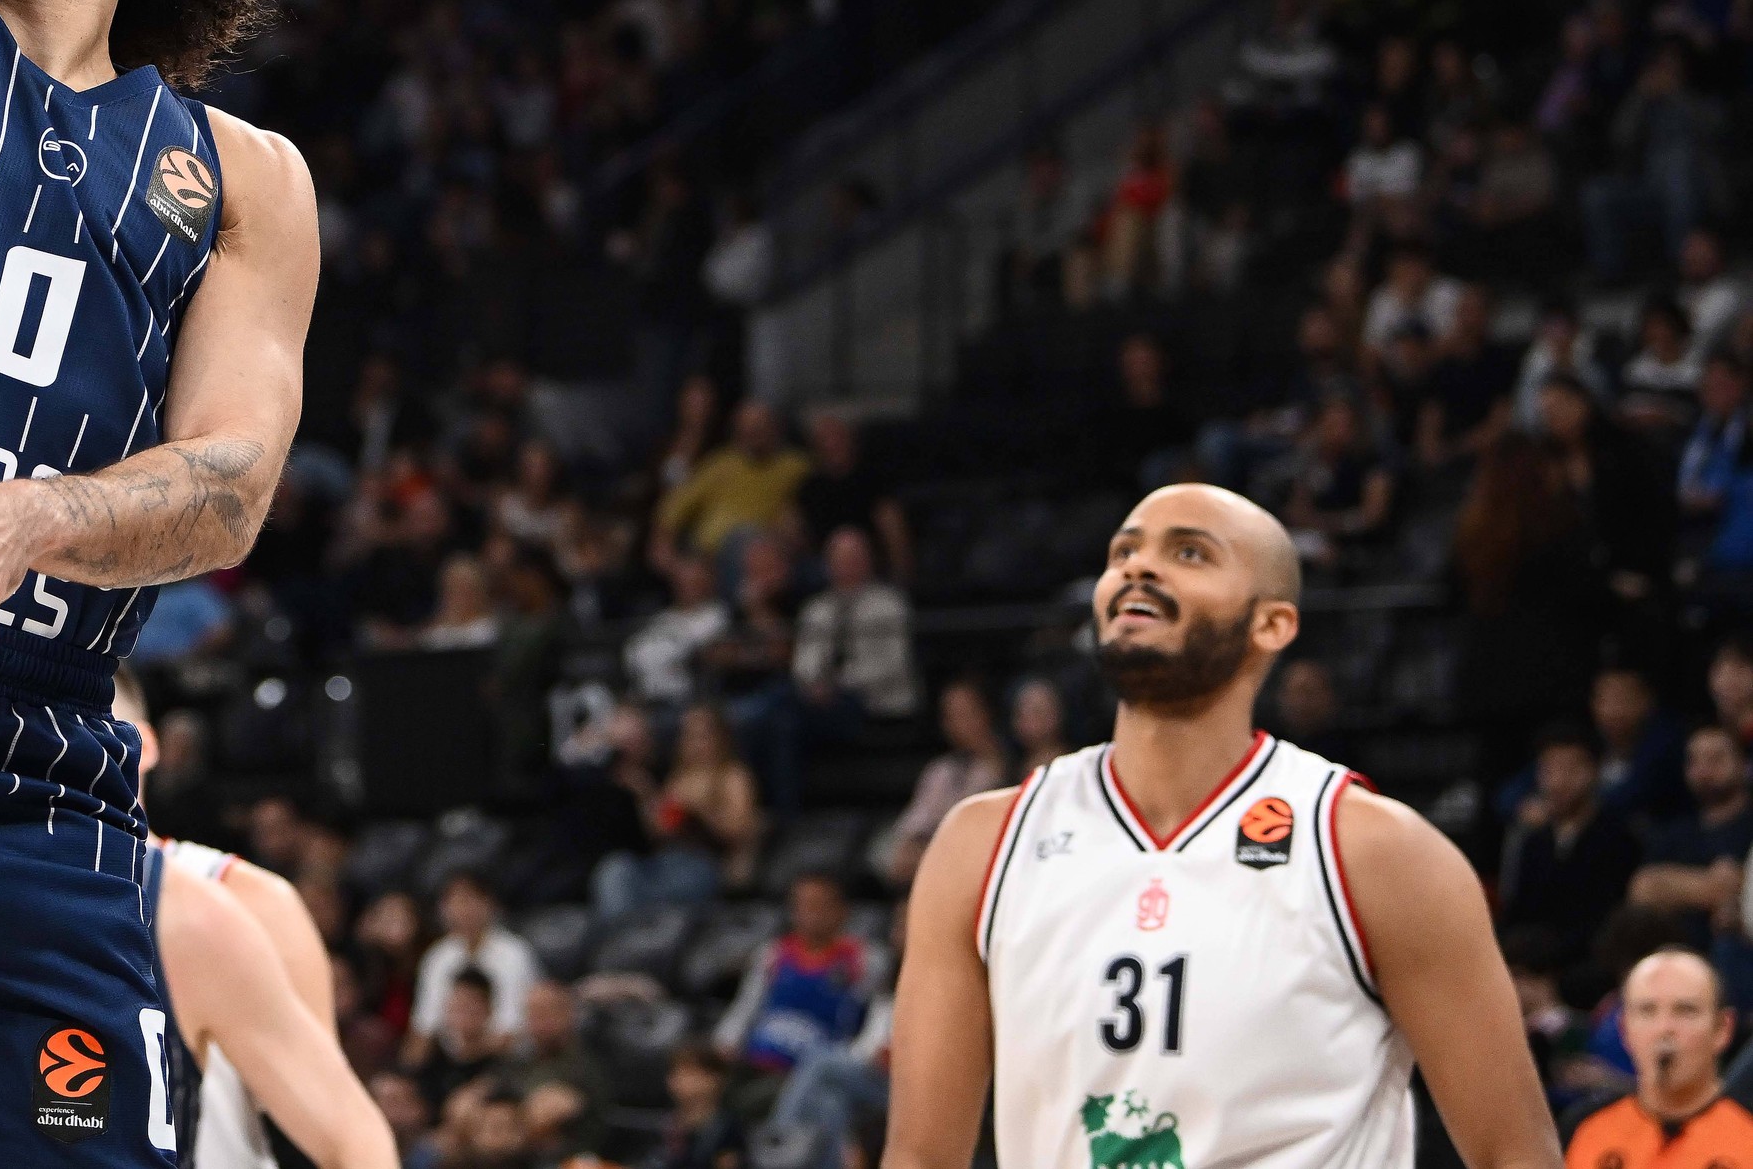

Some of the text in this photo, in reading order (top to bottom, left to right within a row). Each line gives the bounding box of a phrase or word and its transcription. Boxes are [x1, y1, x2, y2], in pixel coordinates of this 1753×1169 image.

[149, 198, 199, 243] abu dhabi
[1099, 953, 1190, 1057] 31
[37, 1113, 104, 1129] abu dhabi
[38, 1107, 75, 1115] experience
